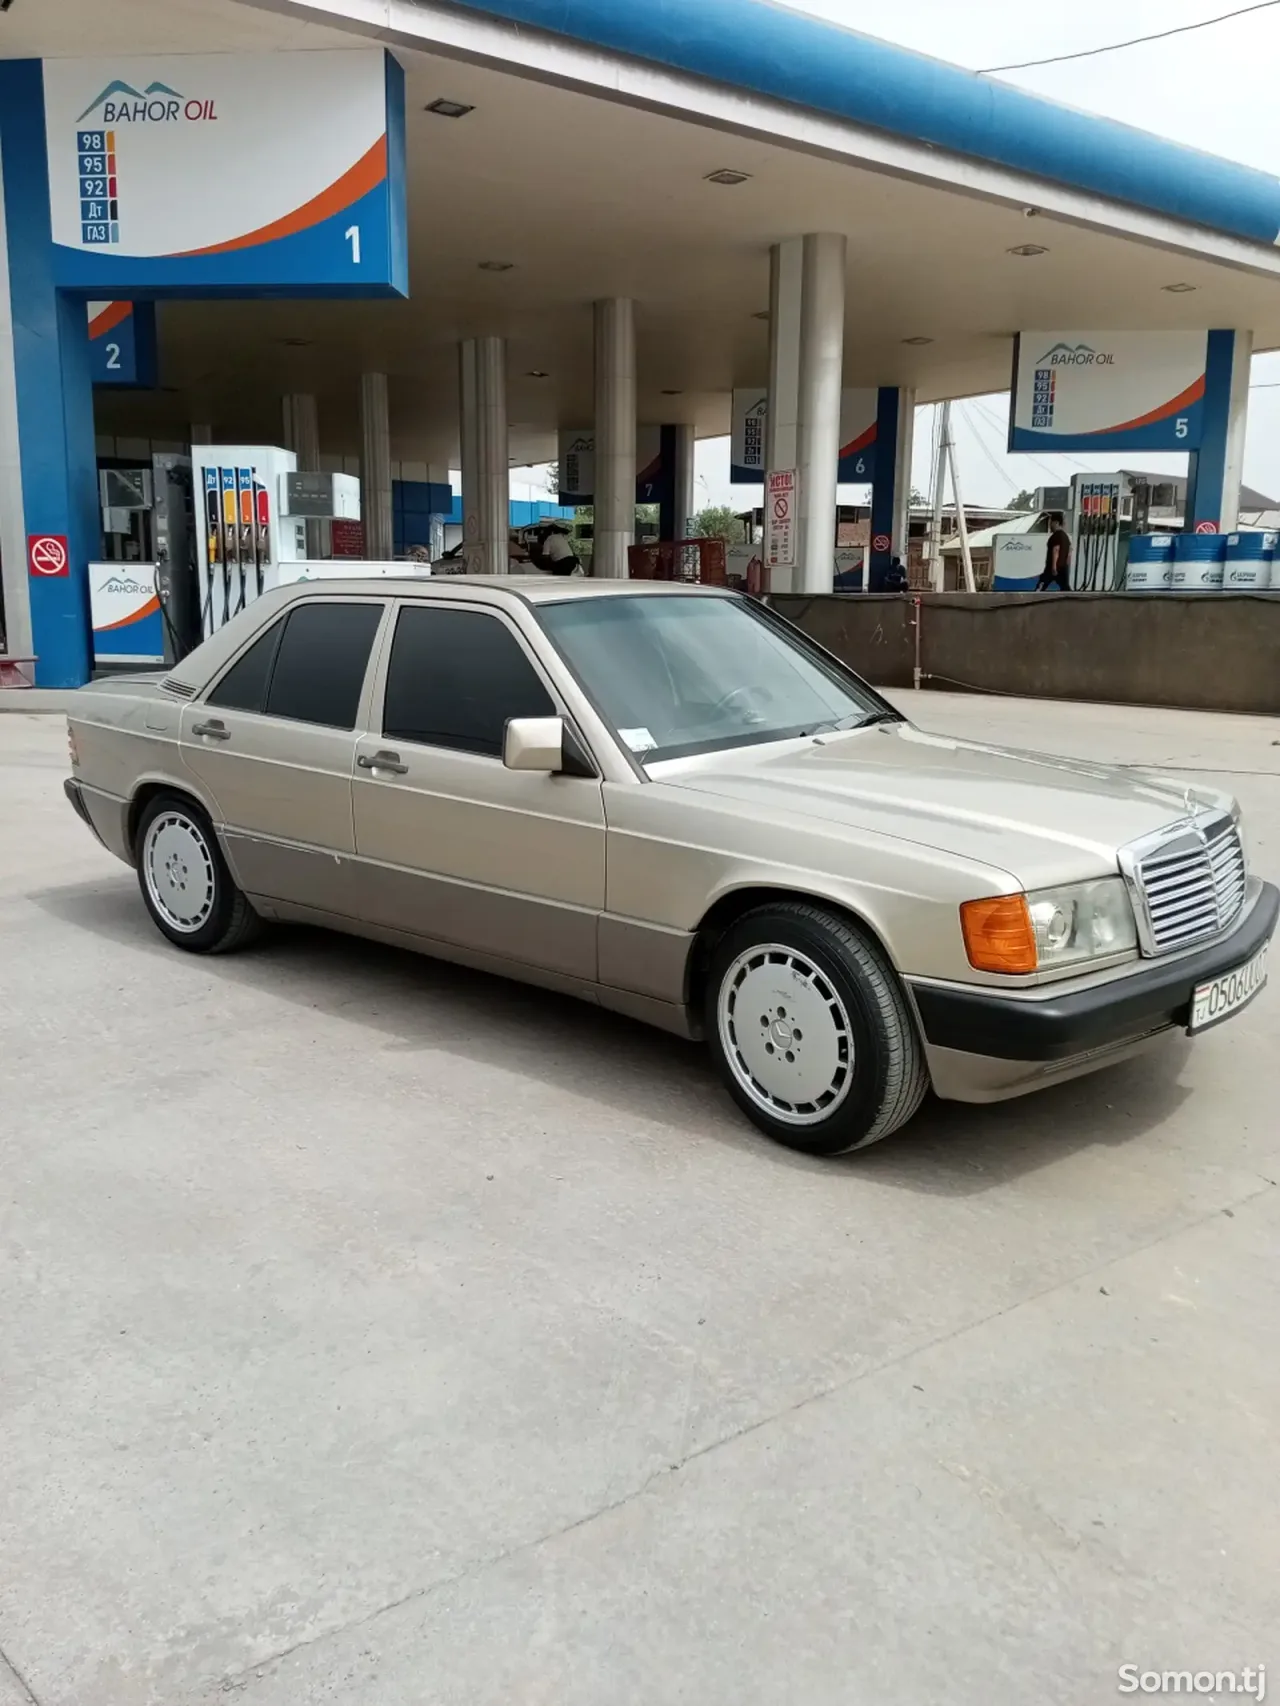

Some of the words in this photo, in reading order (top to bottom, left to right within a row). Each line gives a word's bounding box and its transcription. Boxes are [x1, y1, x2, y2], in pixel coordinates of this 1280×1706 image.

[103, 101, 180, 123] BAHOR
[184, 100, 218, 121] OIL
[82, 134, 101, 149] 98
[84, 157, 103, 173] 95
[85, 180, 104, 195] 92
[87, 226, 106, 241] ГАЗ
[345, 224, 361, 264] 1
[105, 343, 121, 369] 2
[1050, 353, 1094, 366] BAHOR
[1095, 353, 1115, 365] OIL
[1036, 394, 1047, 403] 92
[1175, 418, 1189, 438] 5
[855, 458, 866, 474] 6
[223, 477, 234, 485] 92
[645, 484, 653, 496] 7
[107, 584, 139, 594] BAHOR
[140, 585, 154, 594] OIL
